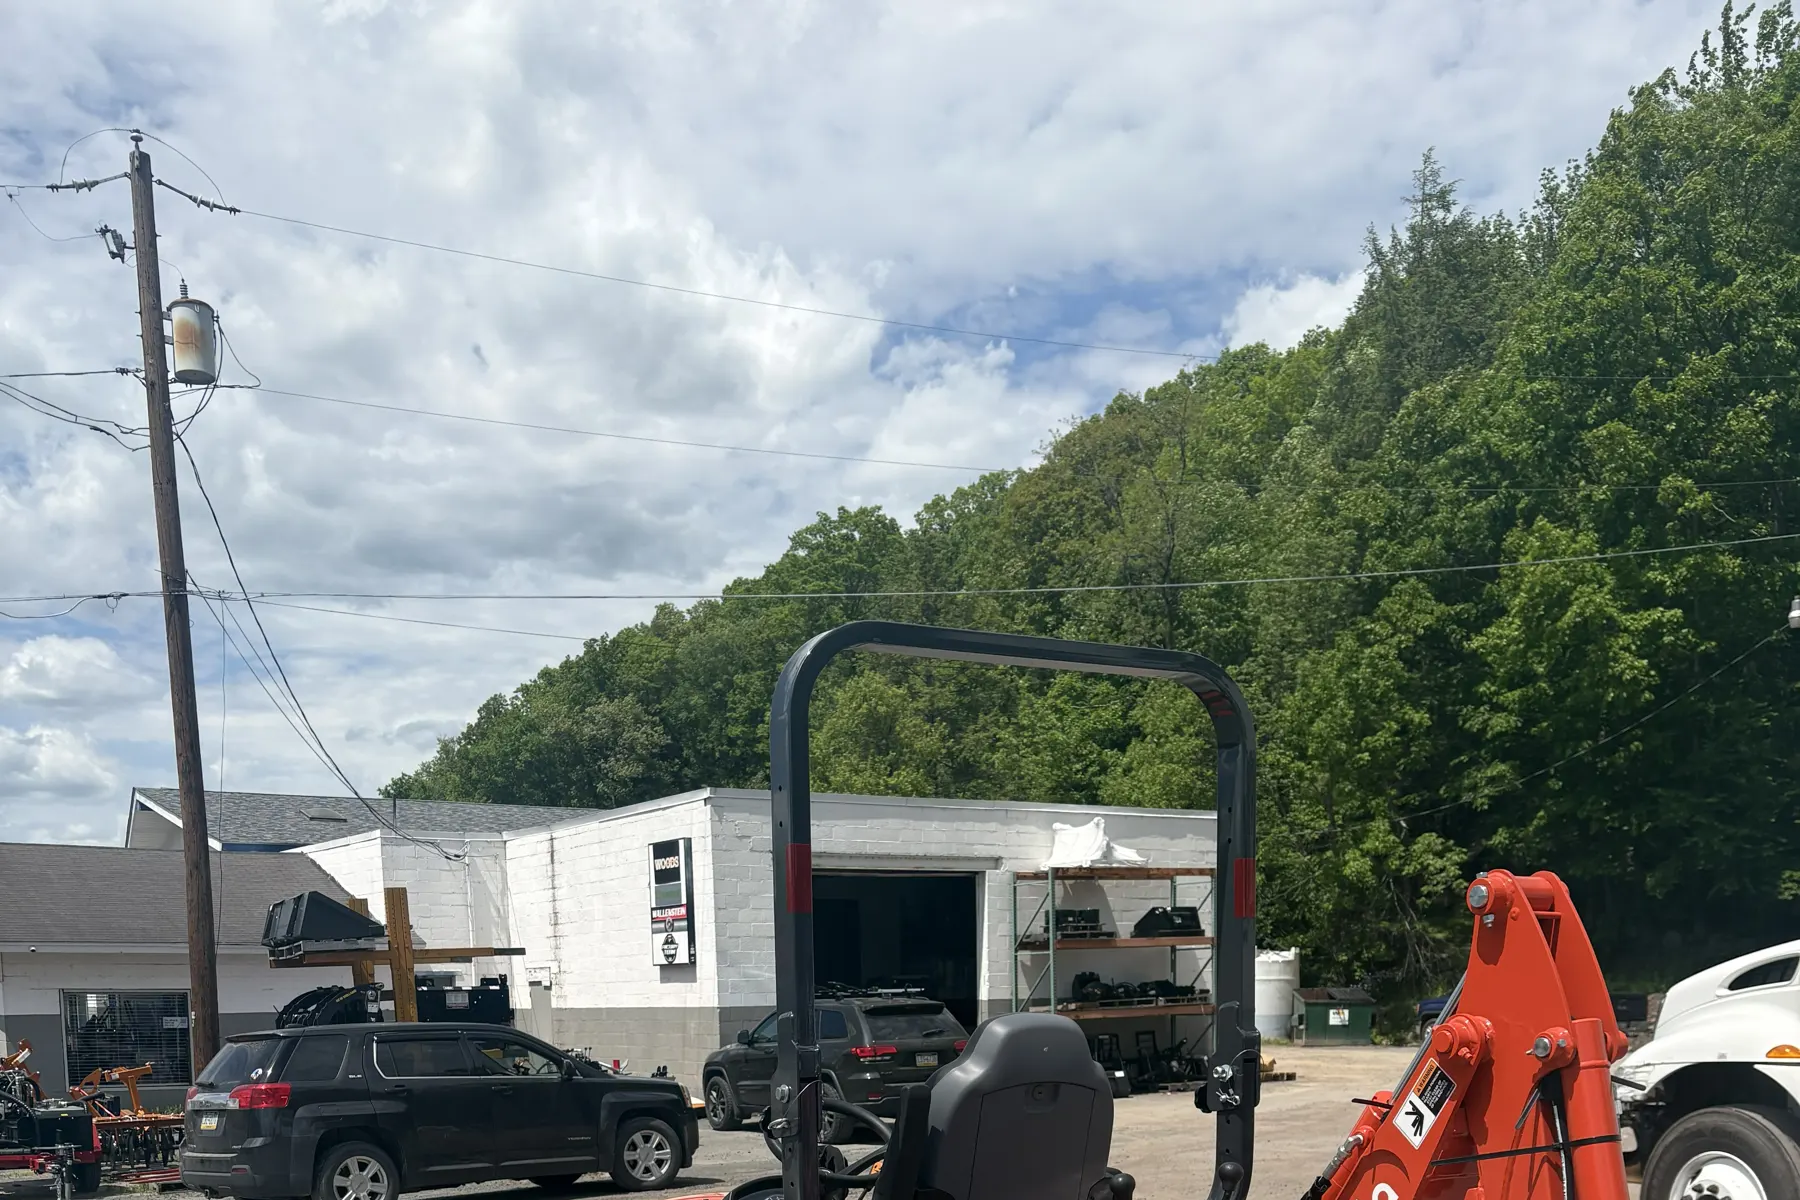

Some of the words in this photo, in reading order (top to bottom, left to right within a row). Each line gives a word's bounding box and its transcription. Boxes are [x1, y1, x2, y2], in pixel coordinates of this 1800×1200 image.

[654, 855, 680, 871] WOODS
[652, 906, 687, 918] WALLENSTEIN
[1419, 1064, 1435, 1087] WARNING
